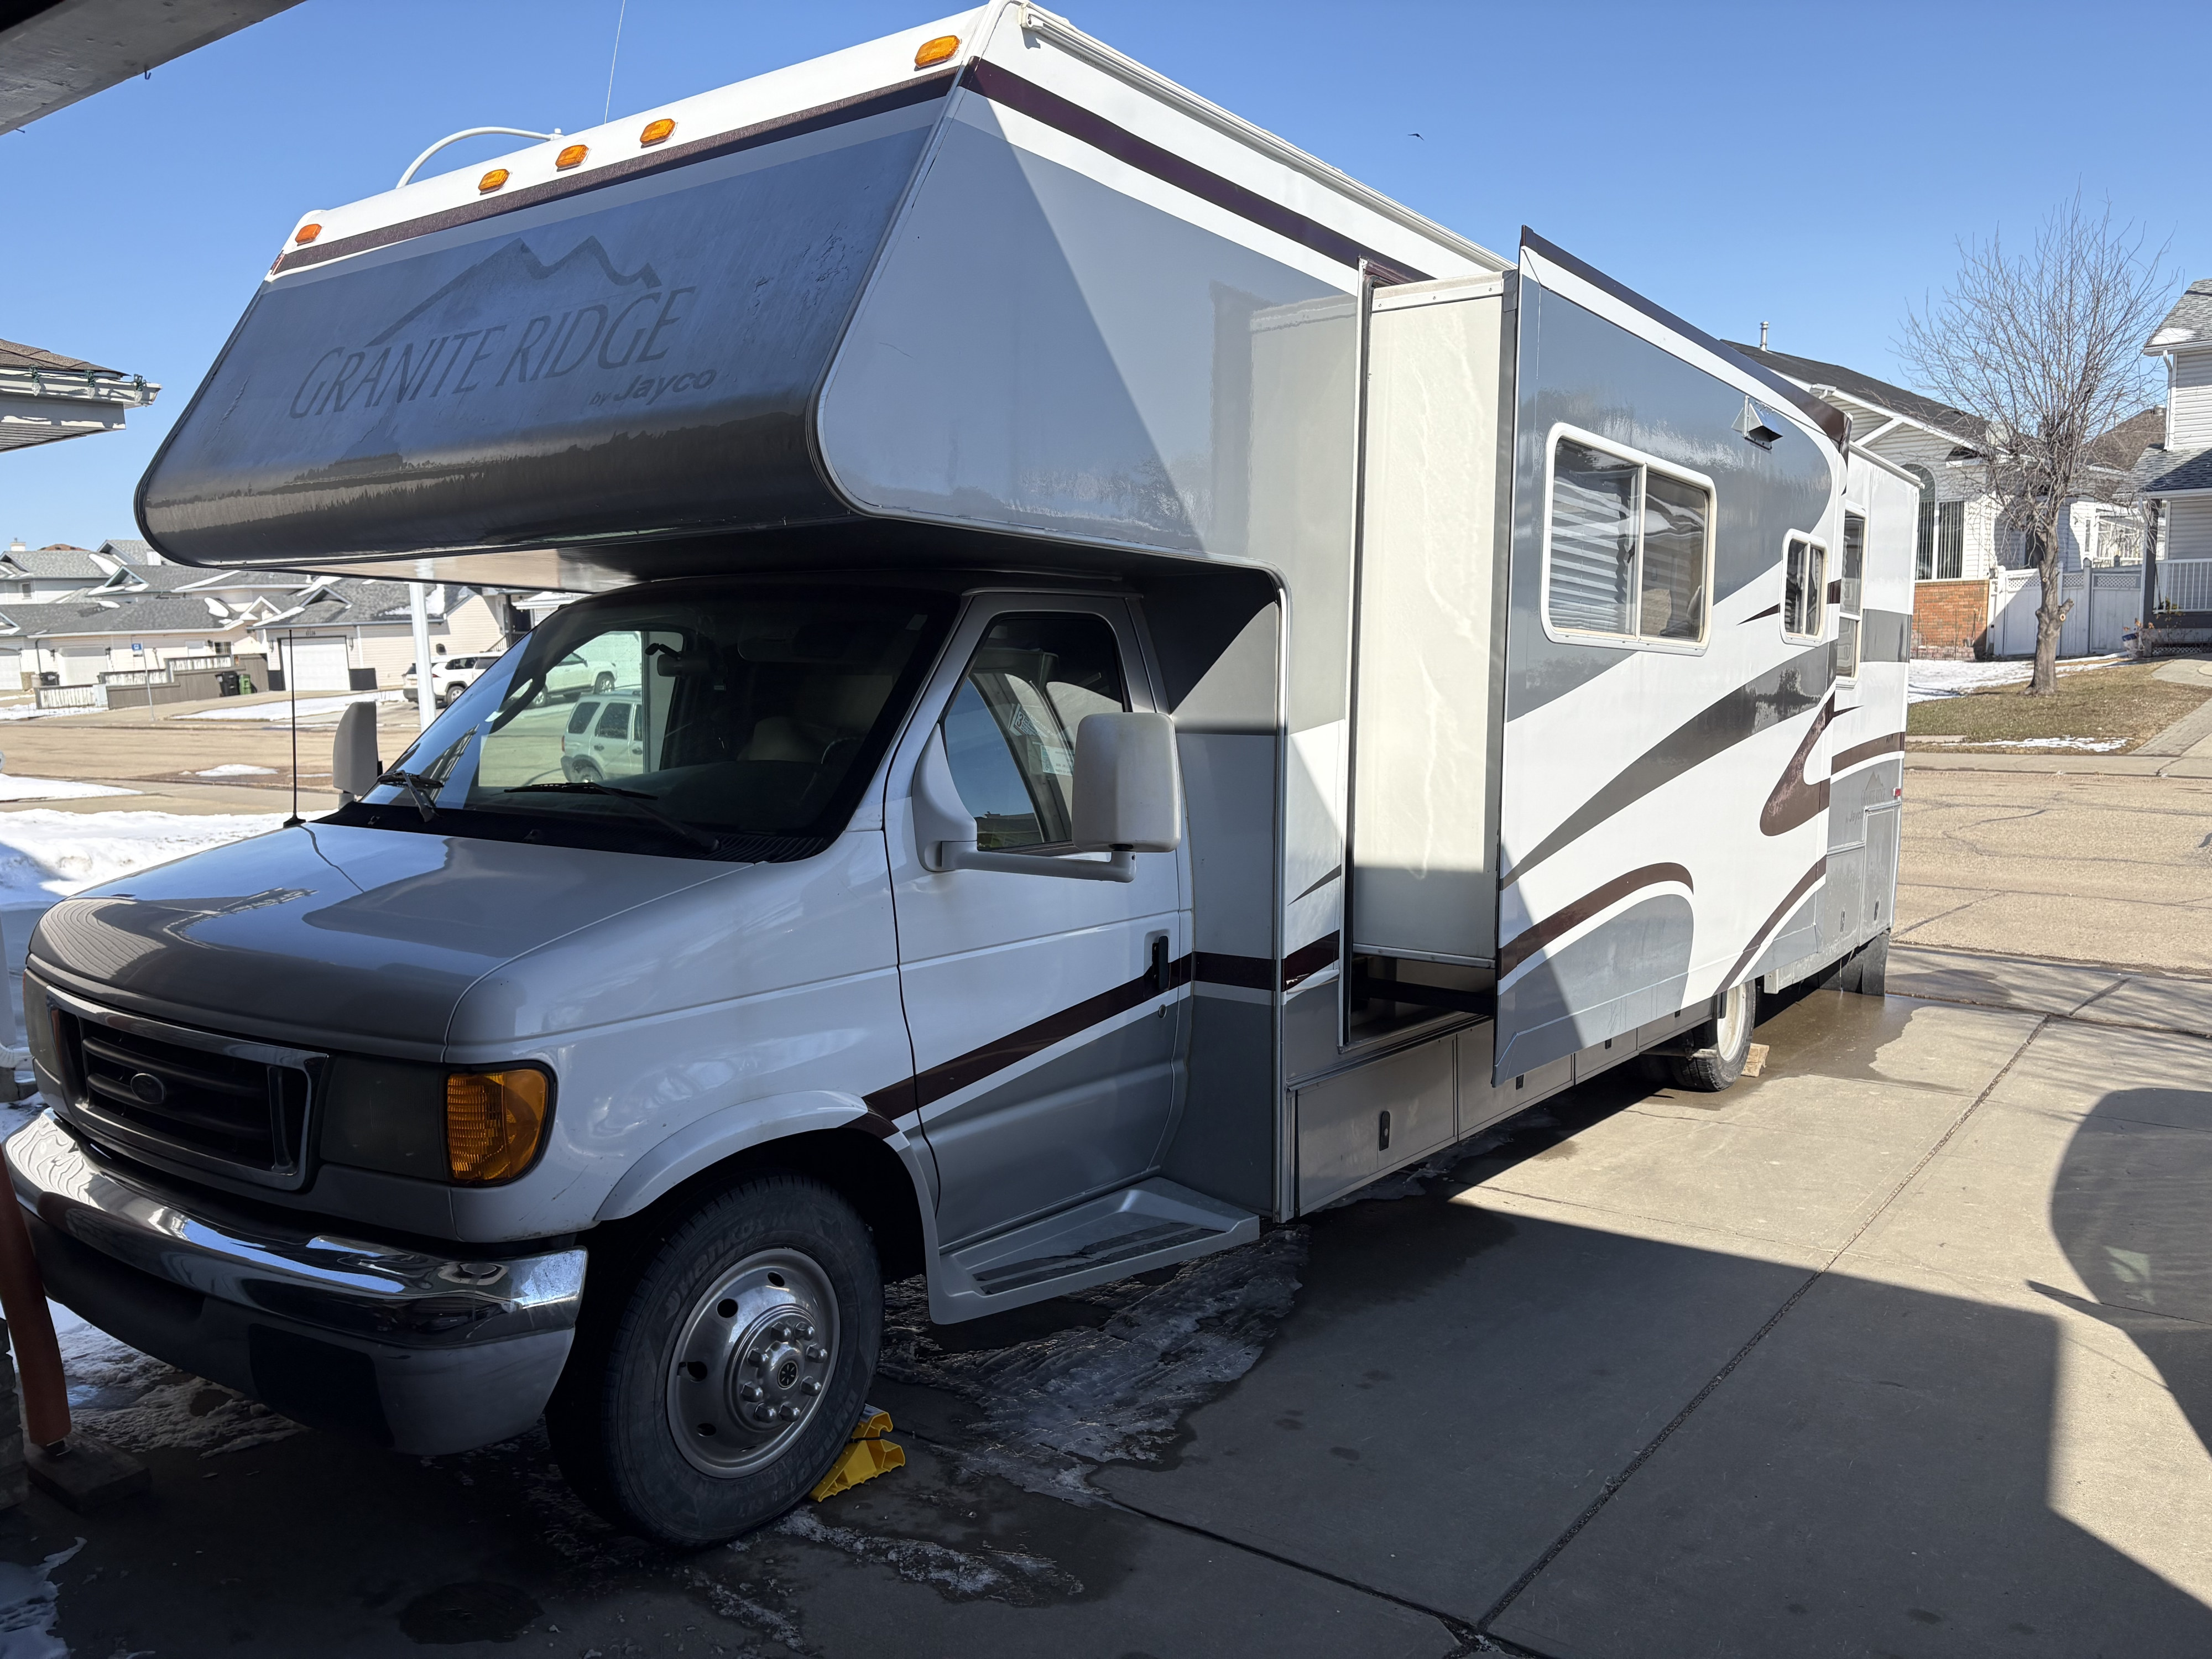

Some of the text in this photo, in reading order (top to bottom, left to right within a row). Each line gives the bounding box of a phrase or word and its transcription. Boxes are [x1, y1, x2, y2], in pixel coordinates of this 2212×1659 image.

[289, 285, 697, 419] GRANITE RIDGE
[589, 369, 717, 407] by Jayco
